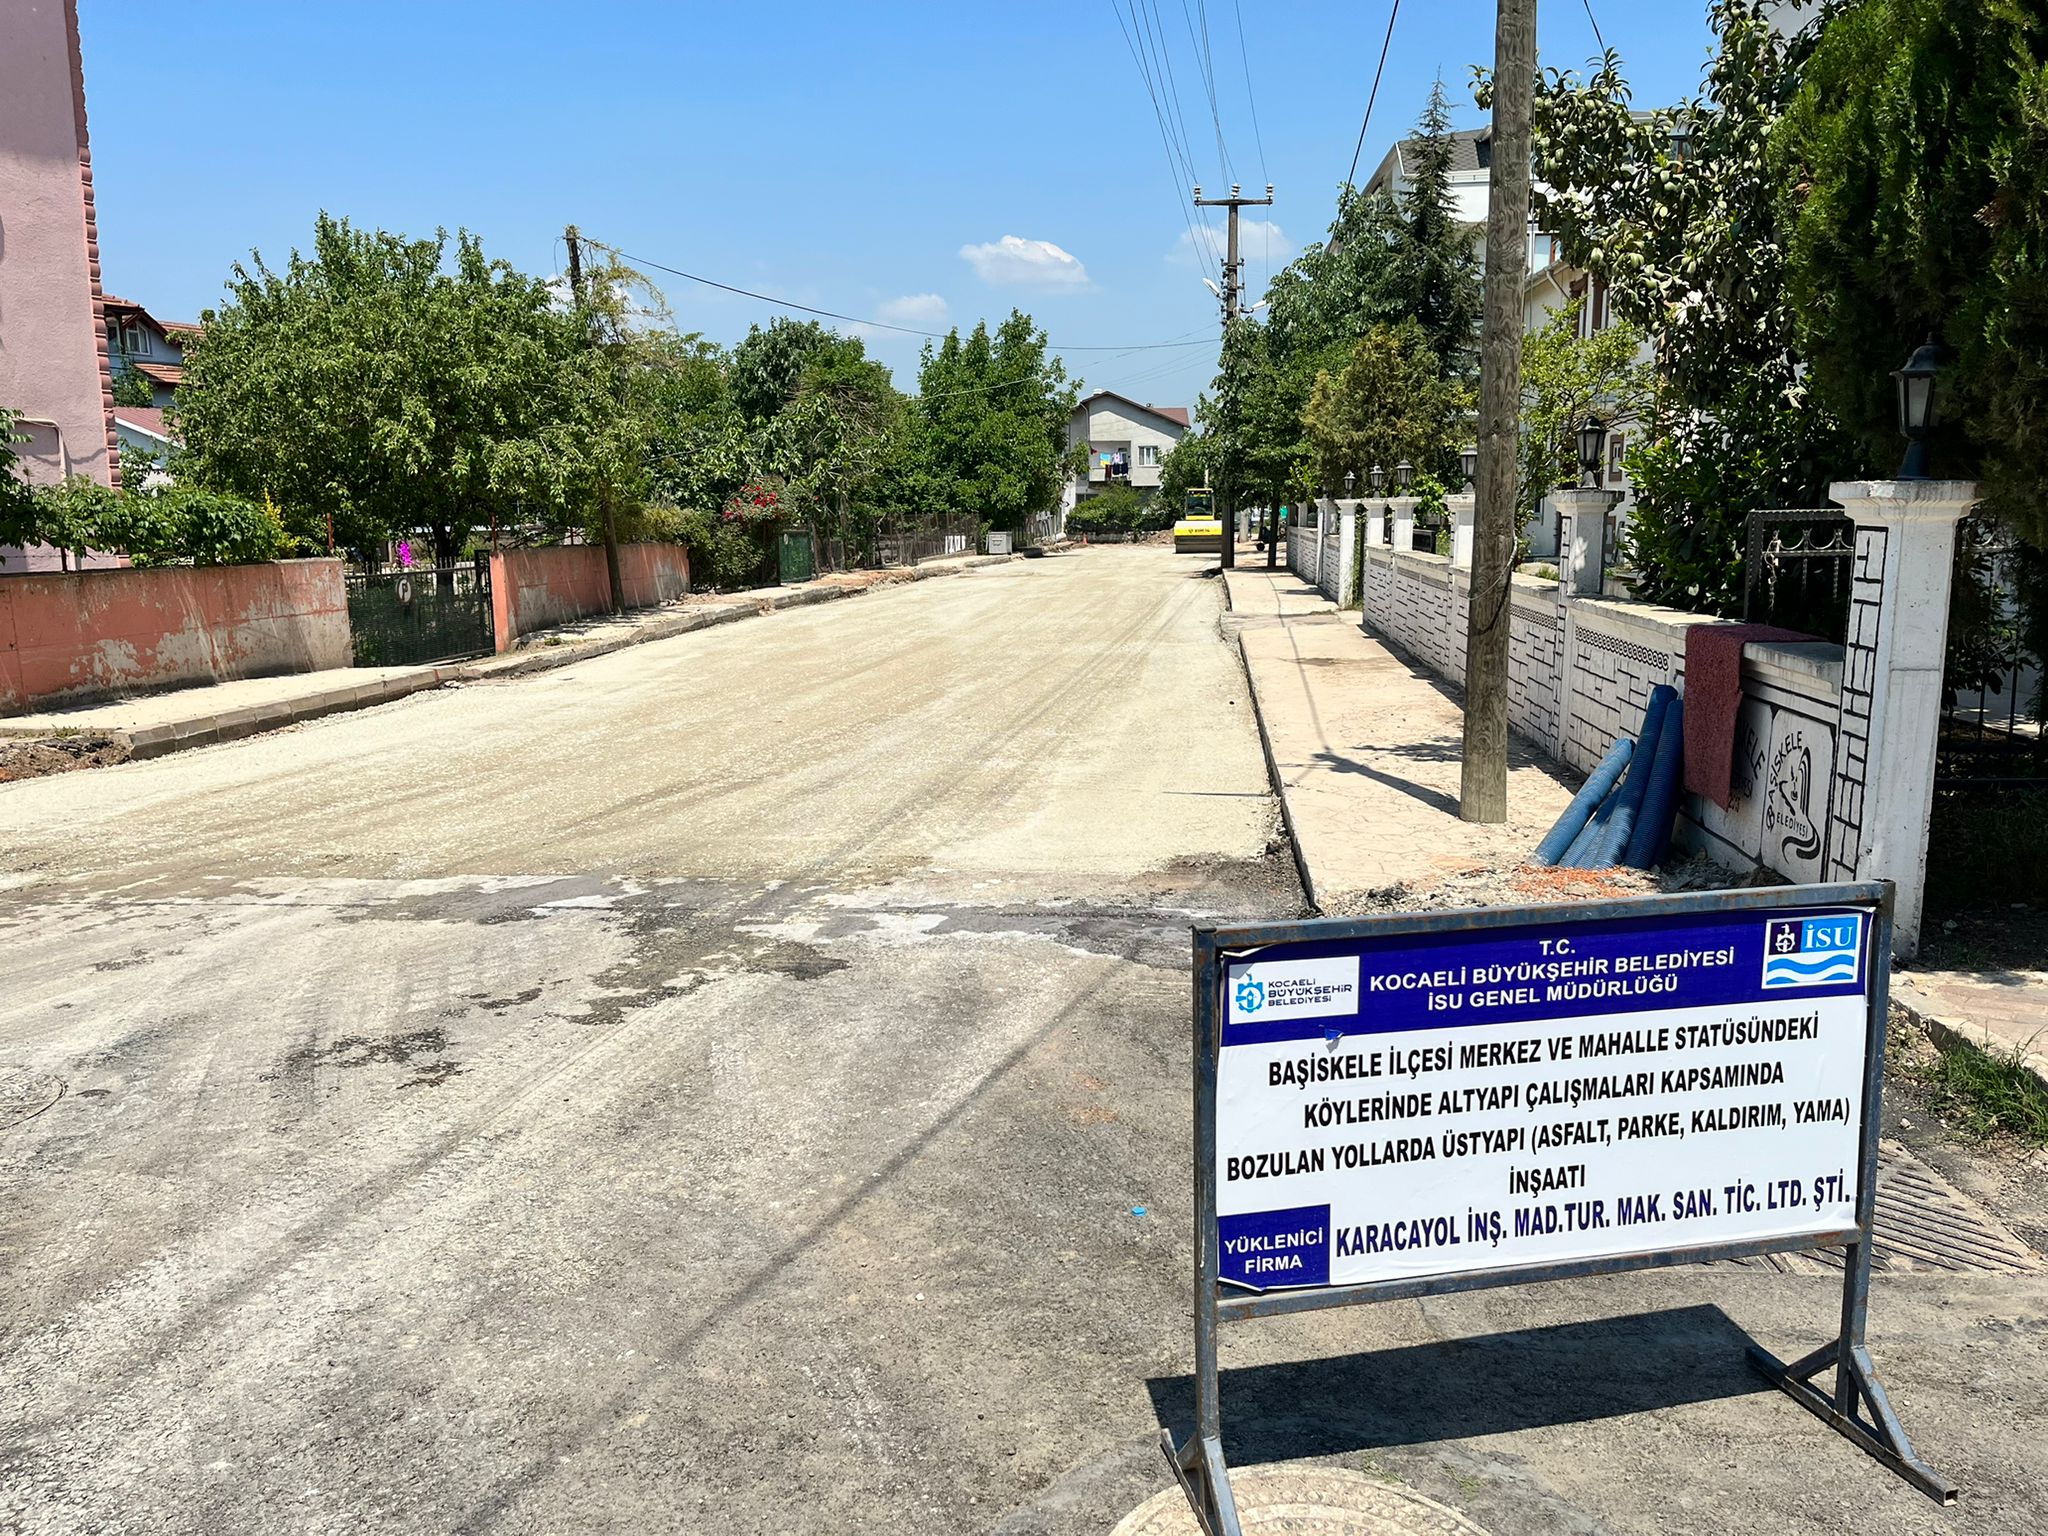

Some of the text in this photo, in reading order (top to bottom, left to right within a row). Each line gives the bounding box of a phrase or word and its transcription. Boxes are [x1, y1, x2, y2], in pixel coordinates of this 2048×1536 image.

[1539, 939, 1576, 956] T.C.
[1805, 924, 1853, 948] İSU
[1268, 978, 1316, 988] KOCAELİ
[1370, 946, 1734, 991] KOCAELİ BÜYÜKŞEHİR BELEDİYESİ
[1268, 984, 1353, 998] BÜYÜKŞEHİR
[1268, 995, 1332, 1007] BELEDİYESİ
[1428, 974, 1678, 1011] İSU GENEL MÜDÜRLÜĞÜ
[1268, 1010, 1819, 1090] BAŞİSKELE İLÇESİ MERKEZ VE MAHALLE STATÜSÜNDEKİ
[1304, 1061, 1784, 1128] KÖYLERİNDE ALTYAPI ÇALIŞMALARI KAPSAMINDA
[1227, 1098, 1850, 1182] BOZULAN YOLLARDA ÜSTYAPI (ASFALT, PARKE, KALDIRIM, YAMA)
[1509, 1165, 1585, 1198] İNŞAATI
[1336, 1217, 1460, 1258] KARACAYOL
[1467, 1207, 1507, 1248] İNŞ.
[1617, 1194, 1666, 1226] MAK.
[1672, 1188, 1717, 1220] SAN.
[1724, 1178, 1761, 1214] TİC.
[1768, 1179, 1806, 1210] LTD.
[1813, 1168, 1850, 1212] ŞTİ.
[1224, 1227, 1323, 1255] YÜKLENİCİ
[1245, 1254, 1303, 1274] FİRMA
